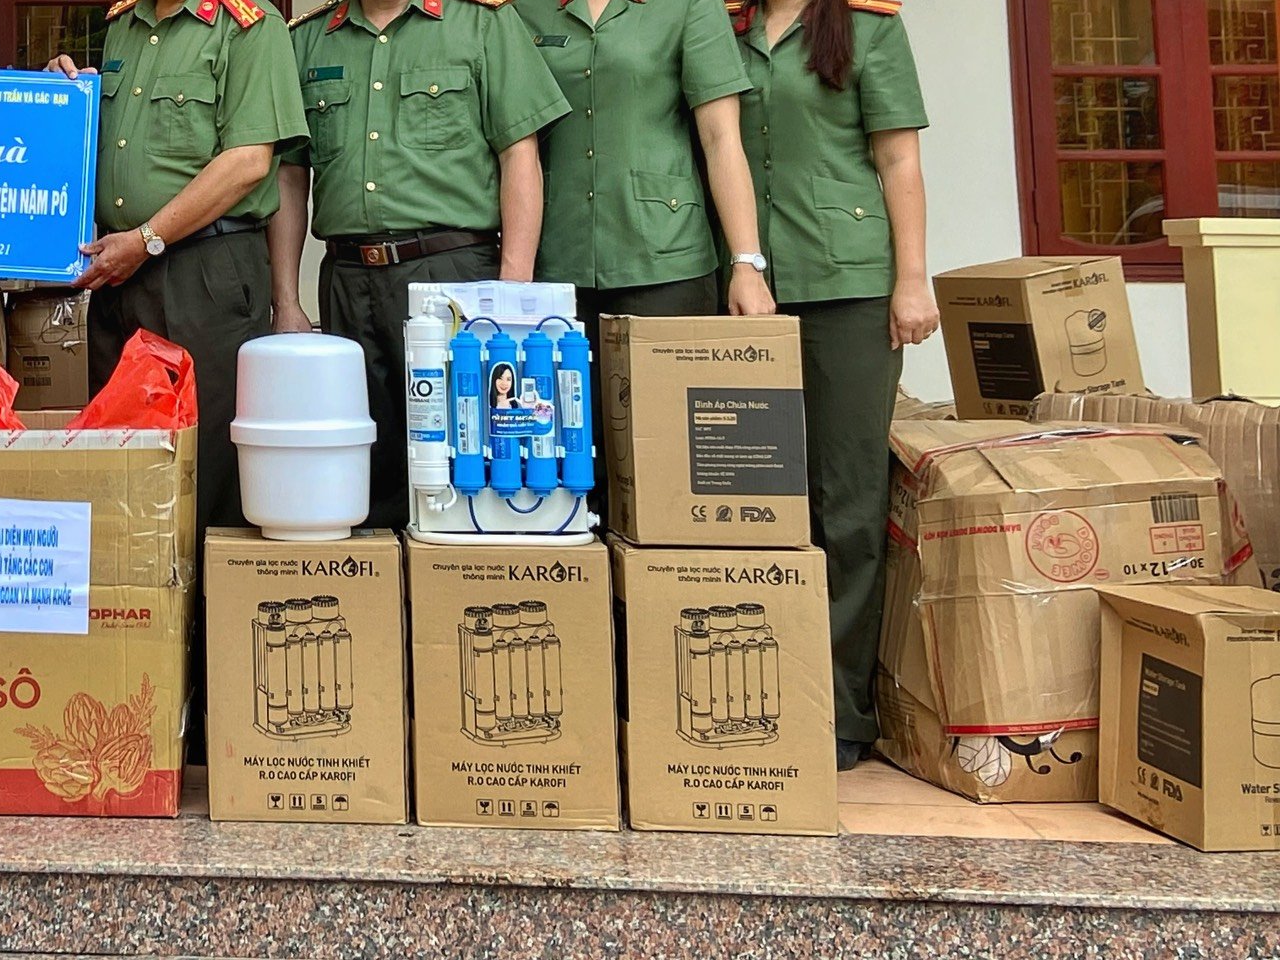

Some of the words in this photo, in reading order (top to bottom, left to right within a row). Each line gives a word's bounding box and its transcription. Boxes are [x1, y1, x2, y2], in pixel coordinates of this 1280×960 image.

[34, 91, 50, 105] CÁC
[53, 93, 69, 107] BẠN
[19, 184, 49, 221] NẬM
[50, 182, 69, 218] PỒ
[714, 399, 724, 411] Áp
[748, 399, 769, 410] Nước
[691, 505, 707, 518] CE
[740, 506, 776, 523] FDA
[227, 558, 254, 567] Chuyên
[256, 559, 267, 568] gia
[268, 559, 278, 568] lọc
[280, 558, 298, 567] nước
[301, 555, 373, 578] KAROFI
[1139, 563, 1147, 573] x
[1149, 560, 1170, 577] 12
[257, 568, 279, 577] thông
[280, 568, 298, 576] minh
[508, 560, 581, 583] KAROFI
[724, 562, 799, 586] KAROFI
[1123, 564, 1138, 576] 10
[88, 608, 152, 620] OPHAR
[244, 755, 265, 766] MÁY
[266, 757, 285, 769] LỌC
[288, 756, 315, 767] NƯỚC
[316, 757, 340, 768] TINH
[341, 755, 371, 768] KHIẾT
[259, 770, 275, 780] R.O
[277, 770, 296, 780] CAO
[298, 768, 318, 780] CẤP
[320, 771, 356, 781] KAROFI
[1162, 778, 1183, 803] FDA
[1241, 783, 1268, 796] Water
